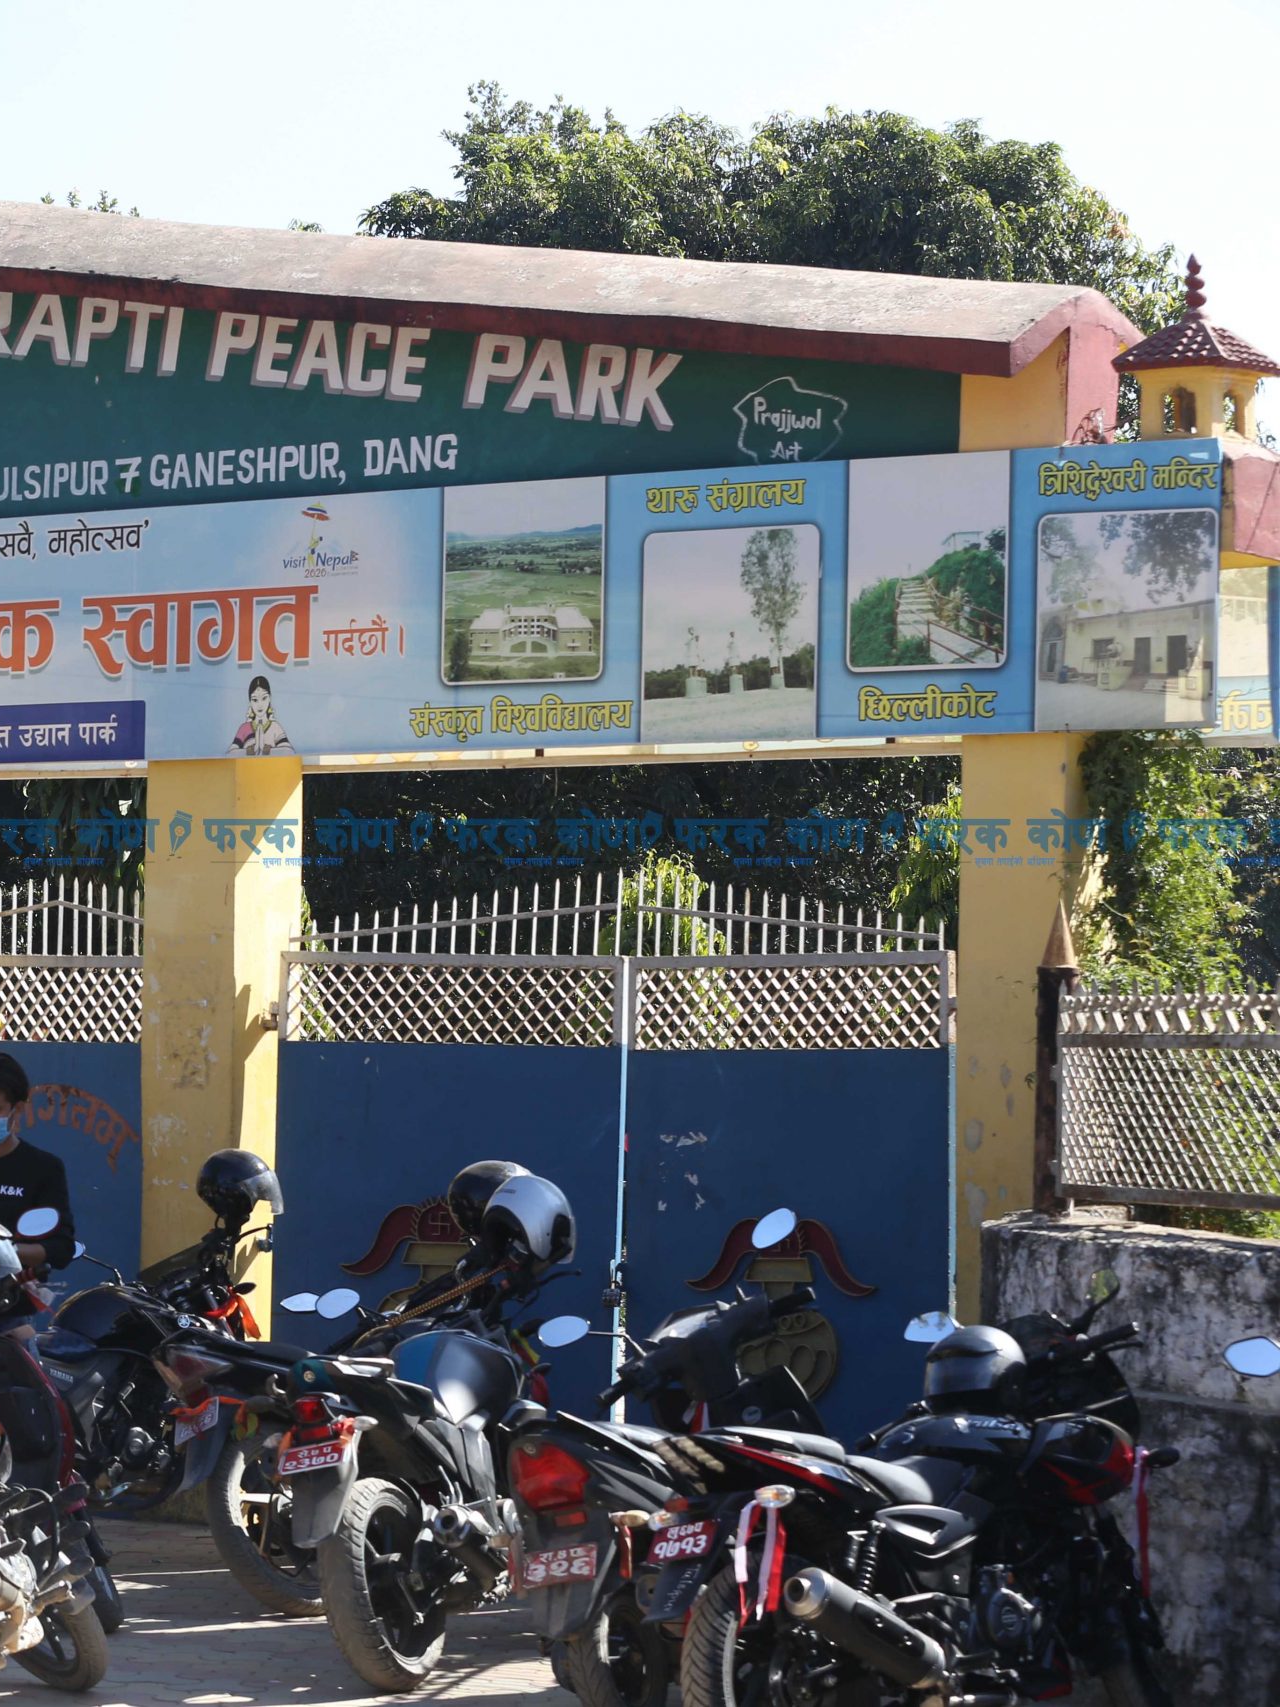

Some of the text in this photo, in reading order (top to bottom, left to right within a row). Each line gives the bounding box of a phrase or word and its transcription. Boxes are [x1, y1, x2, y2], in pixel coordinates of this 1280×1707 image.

[204, 311, 433, 402] PEACE
[462, 330, 683, 433] PARK
[754, 396, 822, 433] Prajjwol
[114, 457, 141, 493] 7
[149, 443, 347, 491] GANESHPUR,
[363, 434, 459, 478] DANG
[769, 441, 804, 461] Art
[1152, 456, 1219, 489] मन्दिर
[282, 556, 307, 569] visit
[315, 551, 353, 571] Nepal
[303, 567, 327, 579] 2020
[82, 585, 319, 677] स्वागत
[18, 723, 71, 748] उद्यान
[78, 714, 118, 746] पार्क
[410, 693, 633, 742] संस्कृत विश्वविद्यालय
[0, 1184, 24, 1197] K&K
